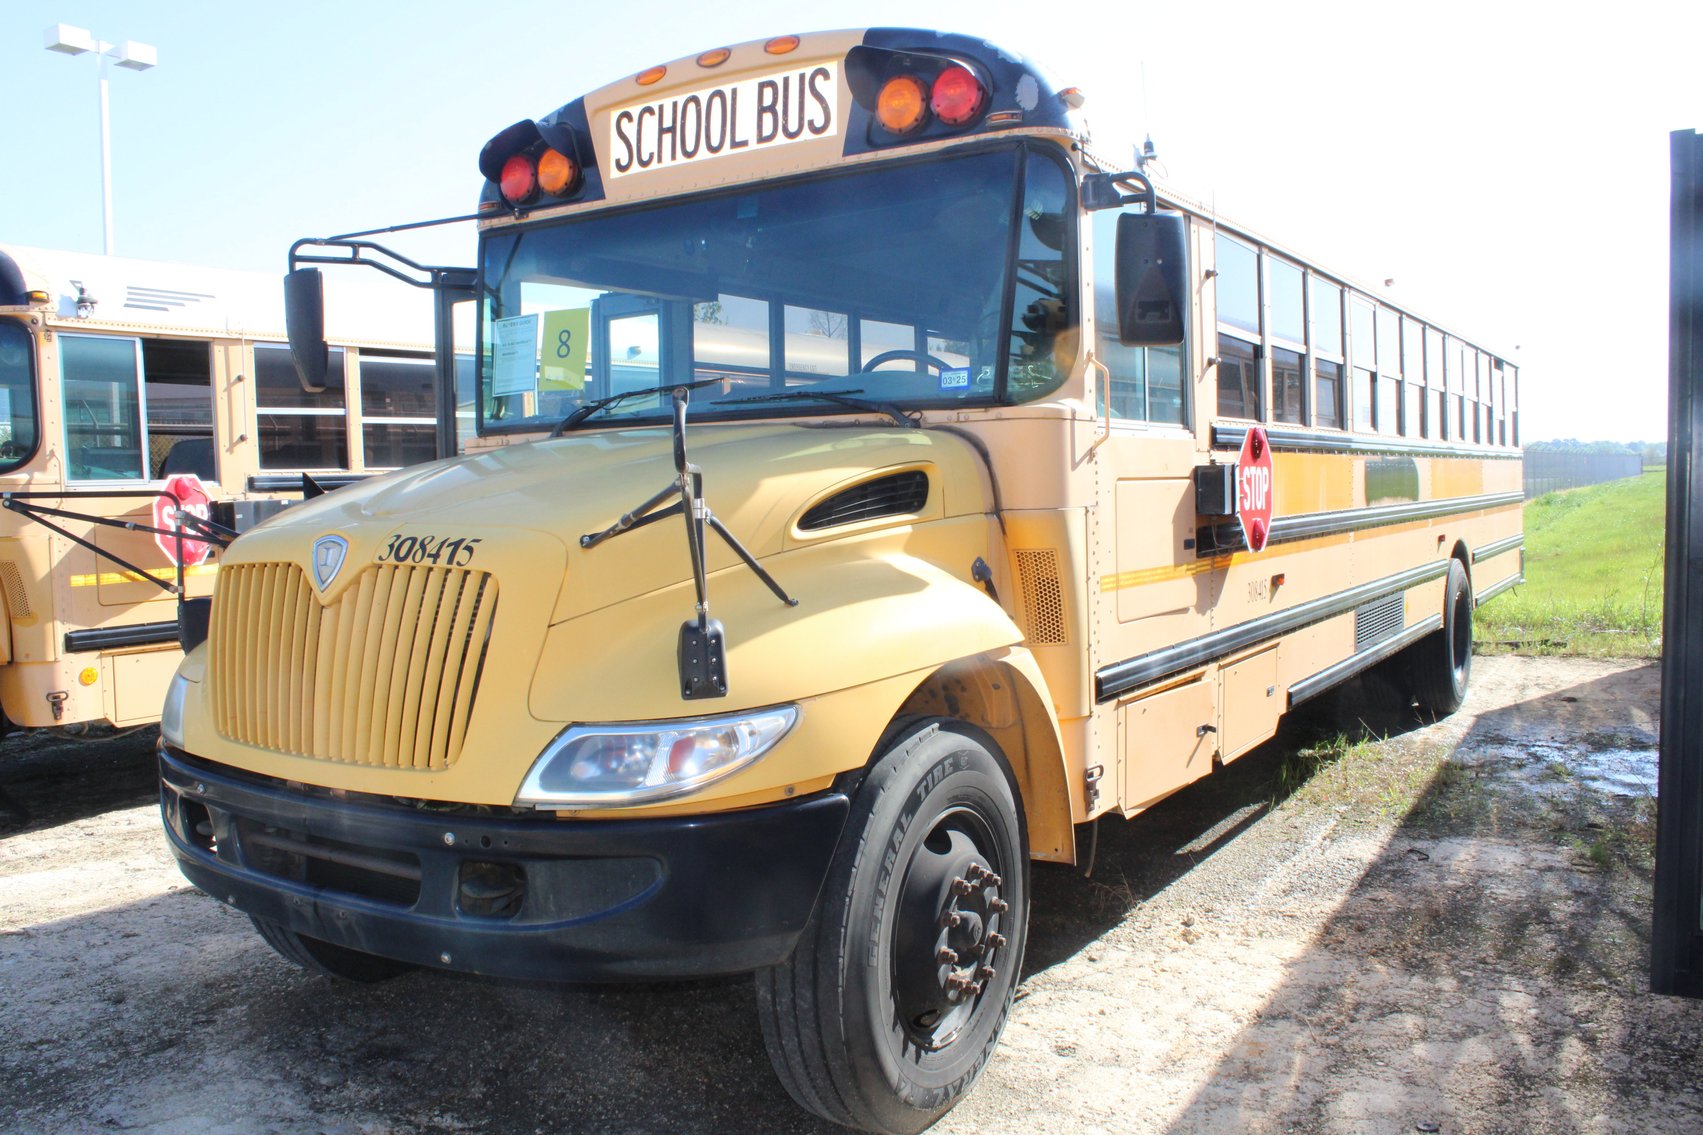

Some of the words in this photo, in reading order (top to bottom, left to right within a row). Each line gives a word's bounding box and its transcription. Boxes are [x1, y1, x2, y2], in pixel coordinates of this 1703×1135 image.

[615, 87, 749, 173] SCHOOL
[756, 67, 831, 145] BUS
[557, 329, 571, 358] 8
[1243, 466, 1269, 511] STOP
[162, 504, 208, 538] SOP
[378, 534, 482, 567] 308415
[867, 812, 912, 967] GENERAL
[917, 757, 954, 801] TIRE
